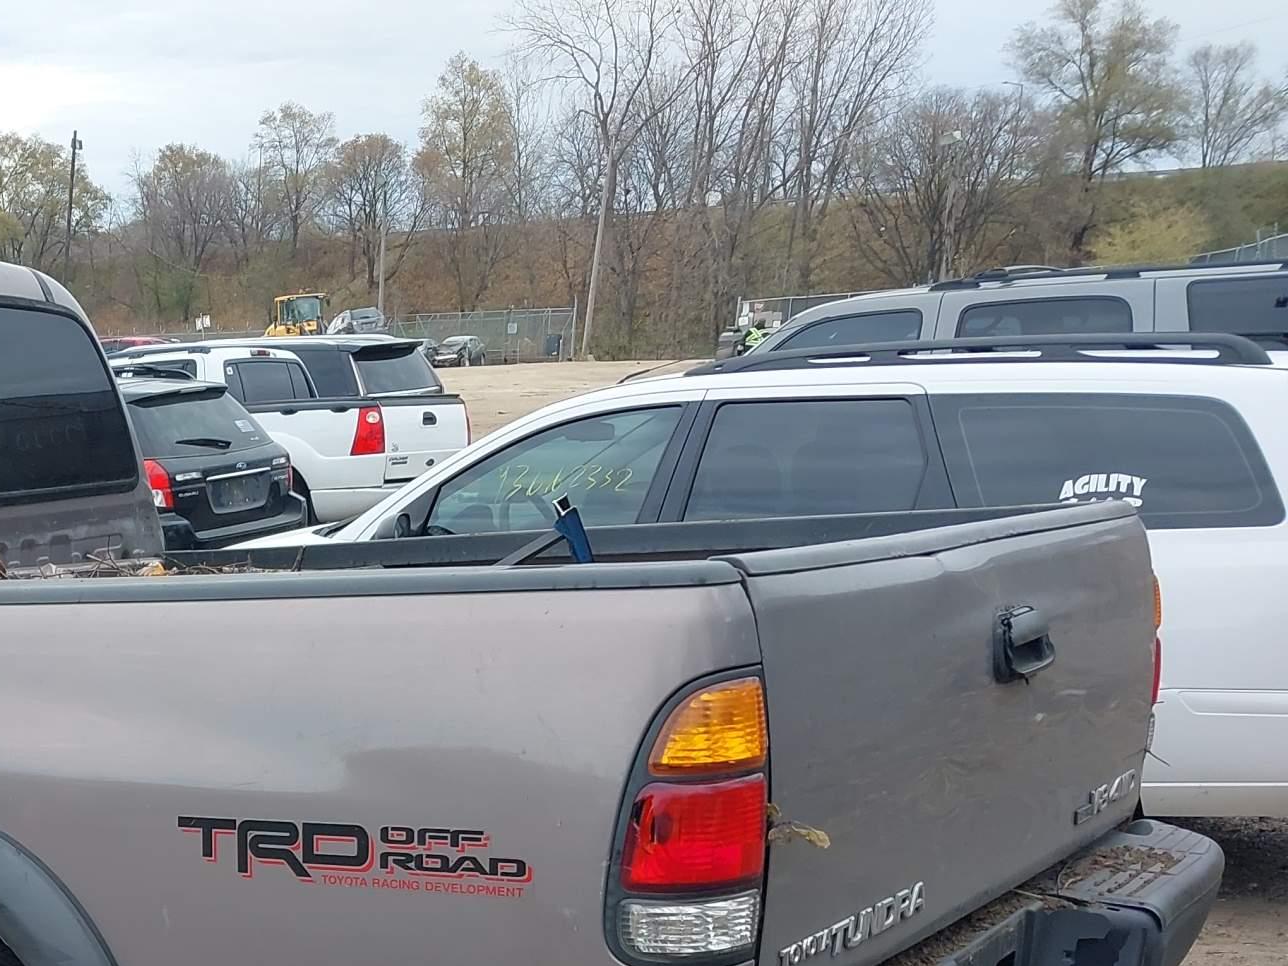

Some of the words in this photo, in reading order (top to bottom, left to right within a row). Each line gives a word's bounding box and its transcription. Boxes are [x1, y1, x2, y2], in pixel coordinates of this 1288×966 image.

[1059, 473, 1148, 500] AGILITY
[177, 815, 374, 883] TRD
[379, 825, 490, 853] OFF
[379, 851, 533, 883] ROAD
[321, 873, 368, 888] TOYOTA
[372, 877, 421, 892] RACING
[424, 881, 525, 898] DEVELOPMENT
[830, 881, 926, 957] TUNDRA
